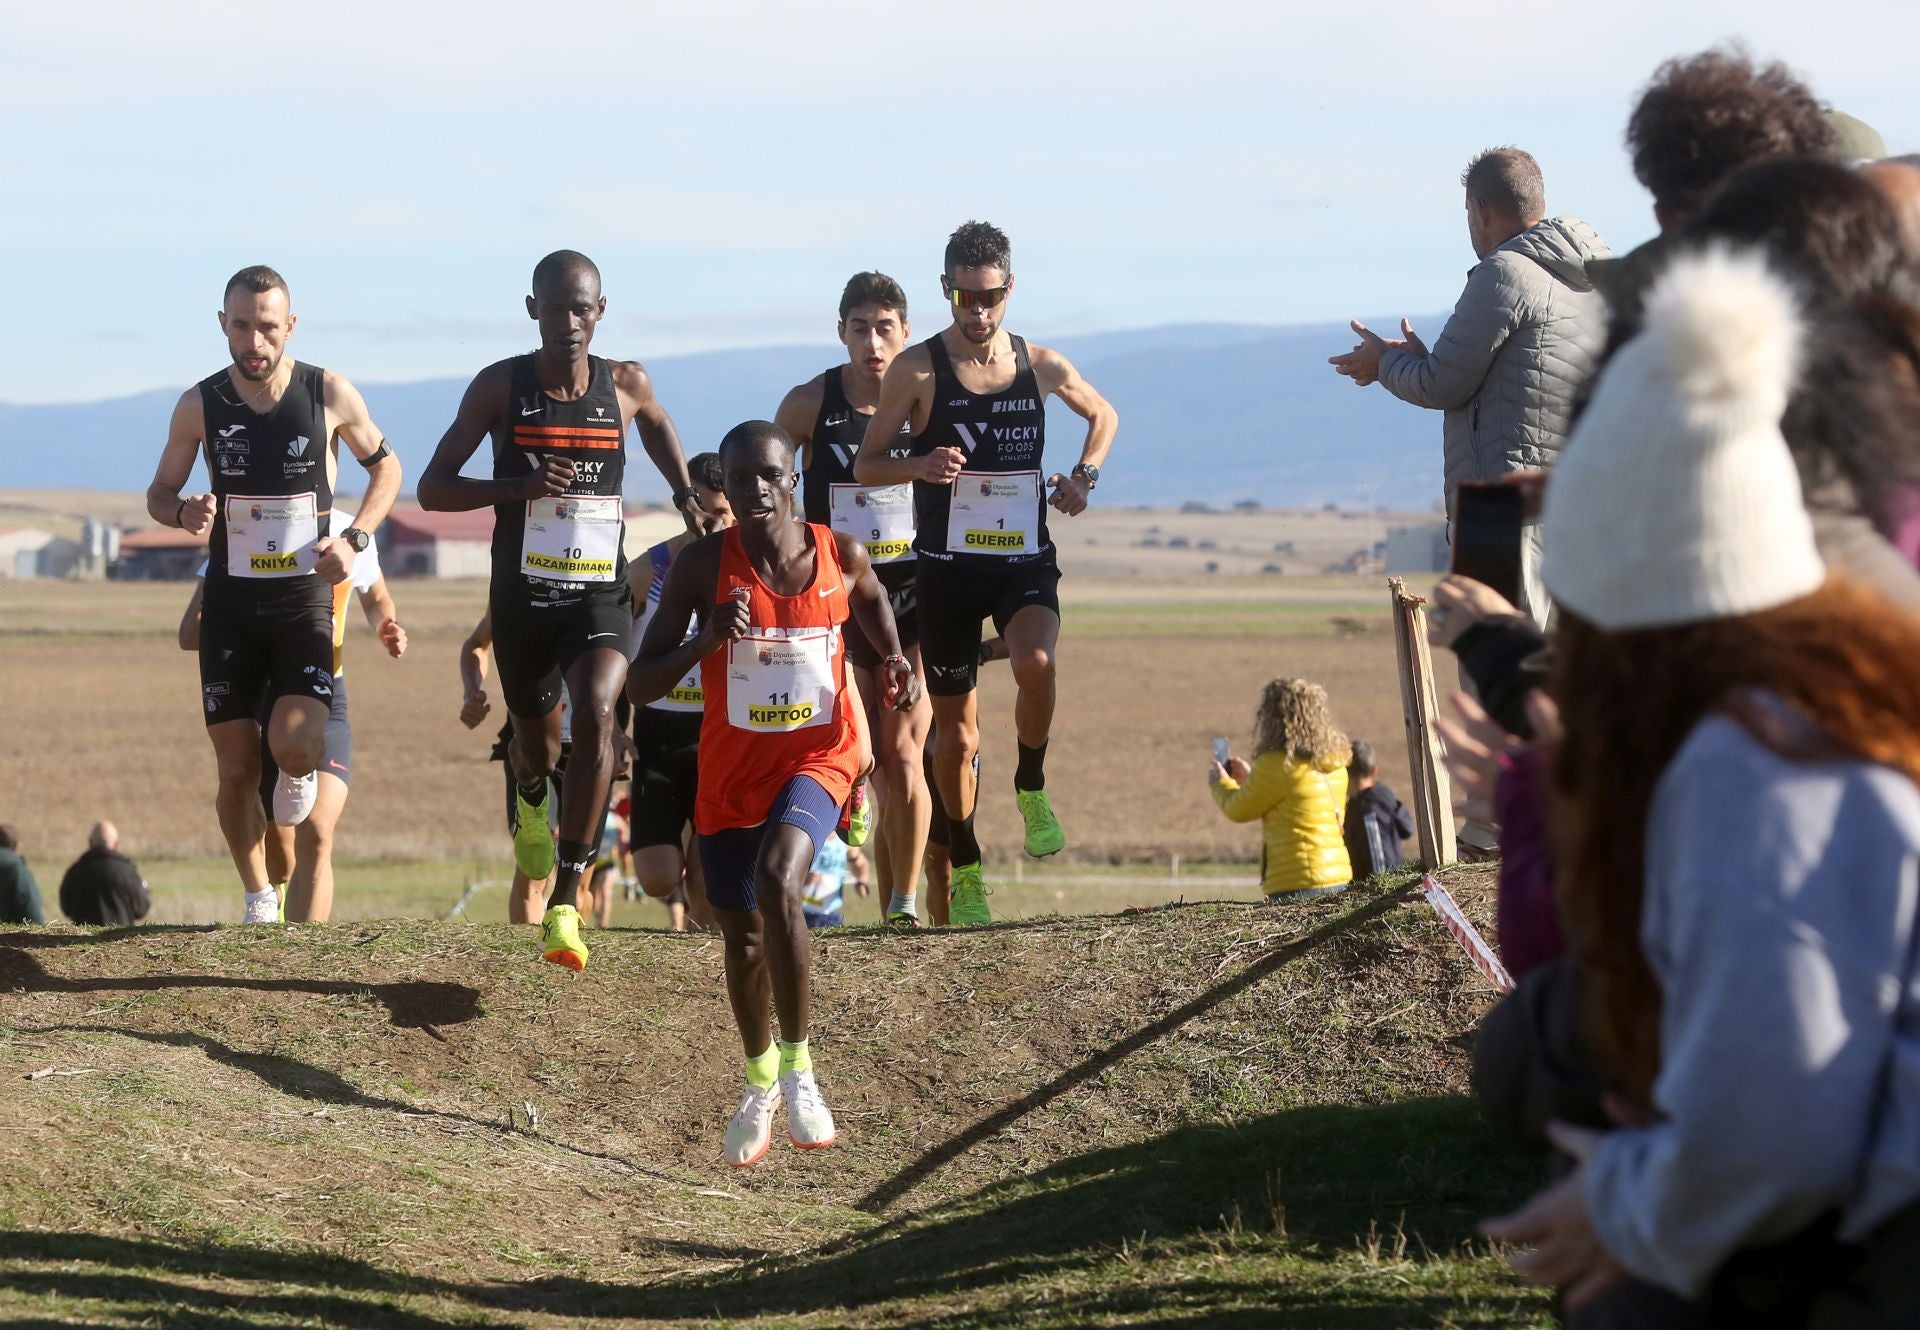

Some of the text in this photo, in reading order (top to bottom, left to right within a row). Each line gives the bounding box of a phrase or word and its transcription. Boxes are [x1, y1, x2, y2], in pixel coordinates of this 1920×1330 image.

[992, 399, 1037, 413] BIKILA
[993, 426, 1038, 441] VICKY
[998, 442, 1034, 453] FOODS
[283, 460, 316, 470] Fundación
[283, 467, 308, 475] Unicaja
[573, 461, 605, 473] CKY
[570, 474, 599, 483] ODS
[996, 518, 1005, 530] 1
[871, 529, 880, 540] 9
[965, 534, 1024, 546] GUERRA
[267, 541, 277, 551] 5
[563, 547, 582, 559] 10
[250, 557, 298, 569] KNIYA
[526, 555, 612, 571] NAZAMBIMANA
[774, 651, 806, 659] Diputación
[687, 677, 695, 687] 3
[769, 692, 789, 705] 11
[749, 707, 812, 722] KIPTOO
